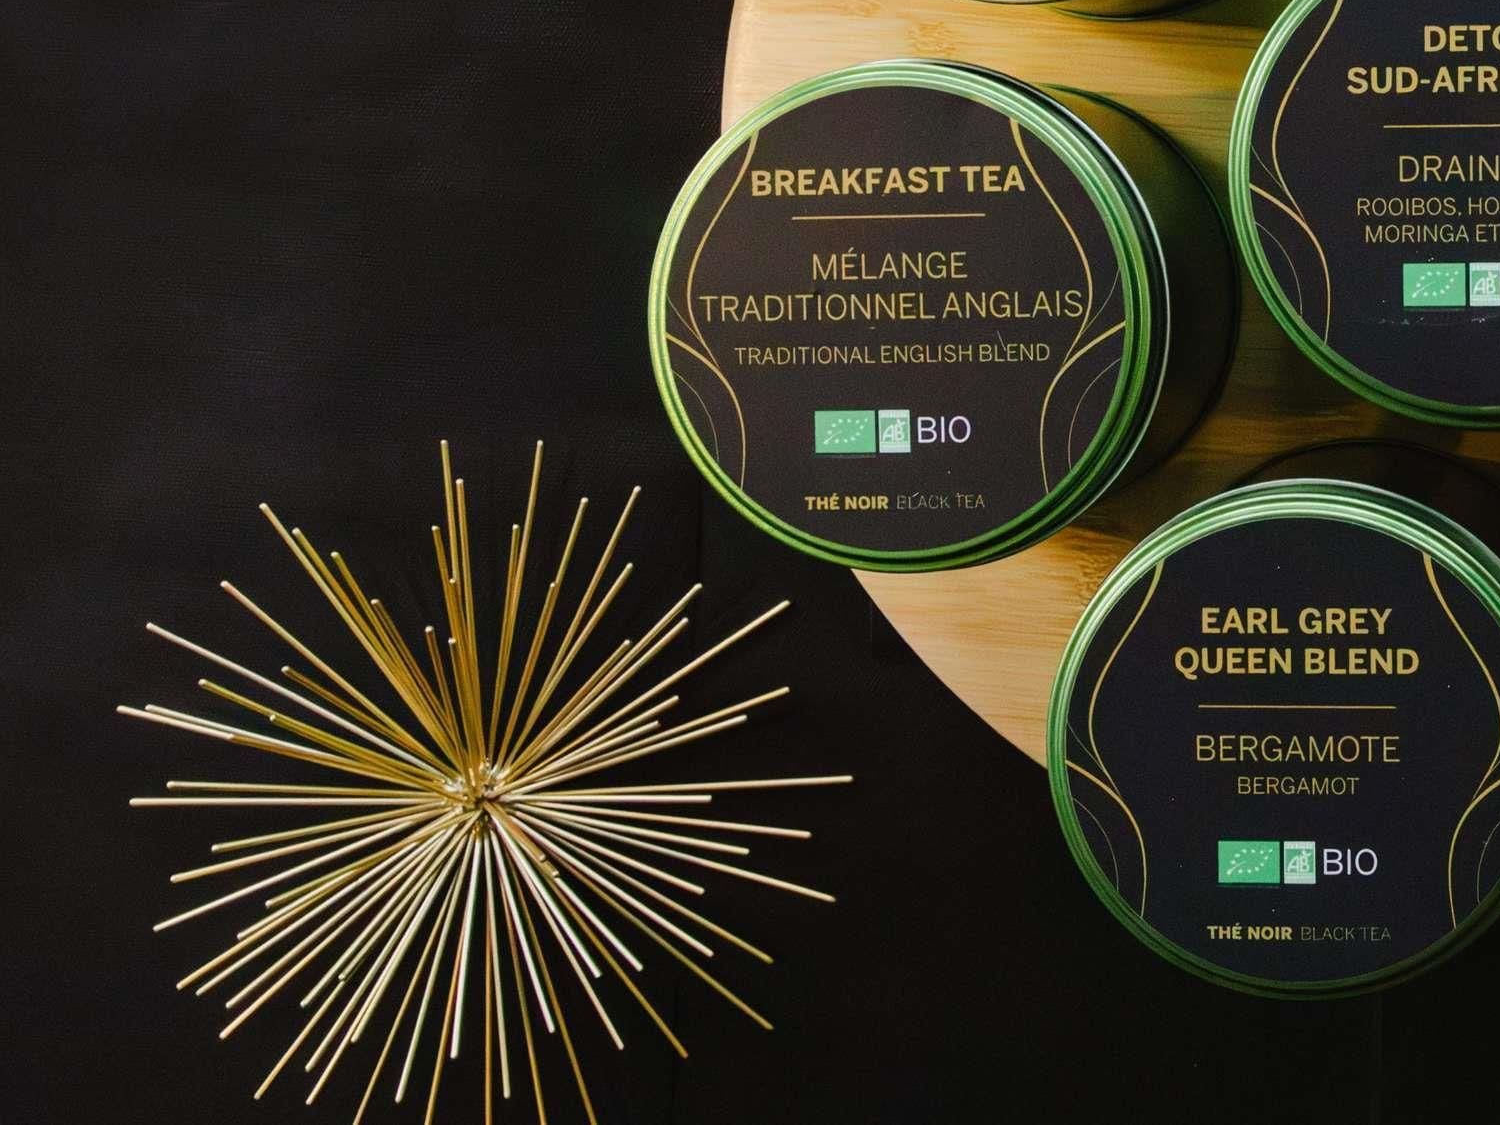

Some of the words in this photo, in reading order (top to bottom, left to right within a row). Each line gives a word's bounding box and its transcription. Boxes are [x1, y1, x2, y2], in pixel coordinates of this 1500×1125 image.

[752, 167, 950, 196] BREAKFAST
[960, 165, 1026, 192] TEA
[1357, 197, 1461, 216] ROOIBOS,
[1365, 224, 1469, 243] MORINGA
[1476, 224, 1500, 242] ET
[813, 247, 967, 280] MÉLANGE
[699, 293, 935, 321] TRADITIONNEL
[943, 290, 1083, 319] ANGLAIS
[734, 346, 875, 365] TRADITIONAL
[881, 344, 972, 363] ENGLISH
[979, 341, 1050, 362] BLEND
[918, 416, 971, 443] BIO
[805, 493, 839, 510] THÉ
[845, 496, 888, 509] NOIR
[897, 492, 950, 509] BLACK
[956, 492, 985, 508] TEA
[1202, 608, 1288, 634] EARL
[1299, 608, 1391, 634] GREY
[1175, 647, 1291, 680] QUEEN
[1305, 648, 1419, 674] BLEND
[1196, 735, 1400, 762] BERGAMOTE
[1238, 776, 1359, 795] BERGAMOT
[1323, 849, 1377, 875] BIO
[1207, 923, 1242, 939] THÉ
[1248, 926, 1292, 940] NOIR
[1301, 927, 1354, 941] BLACK
[1360, 927, 1391, 941] TEA
